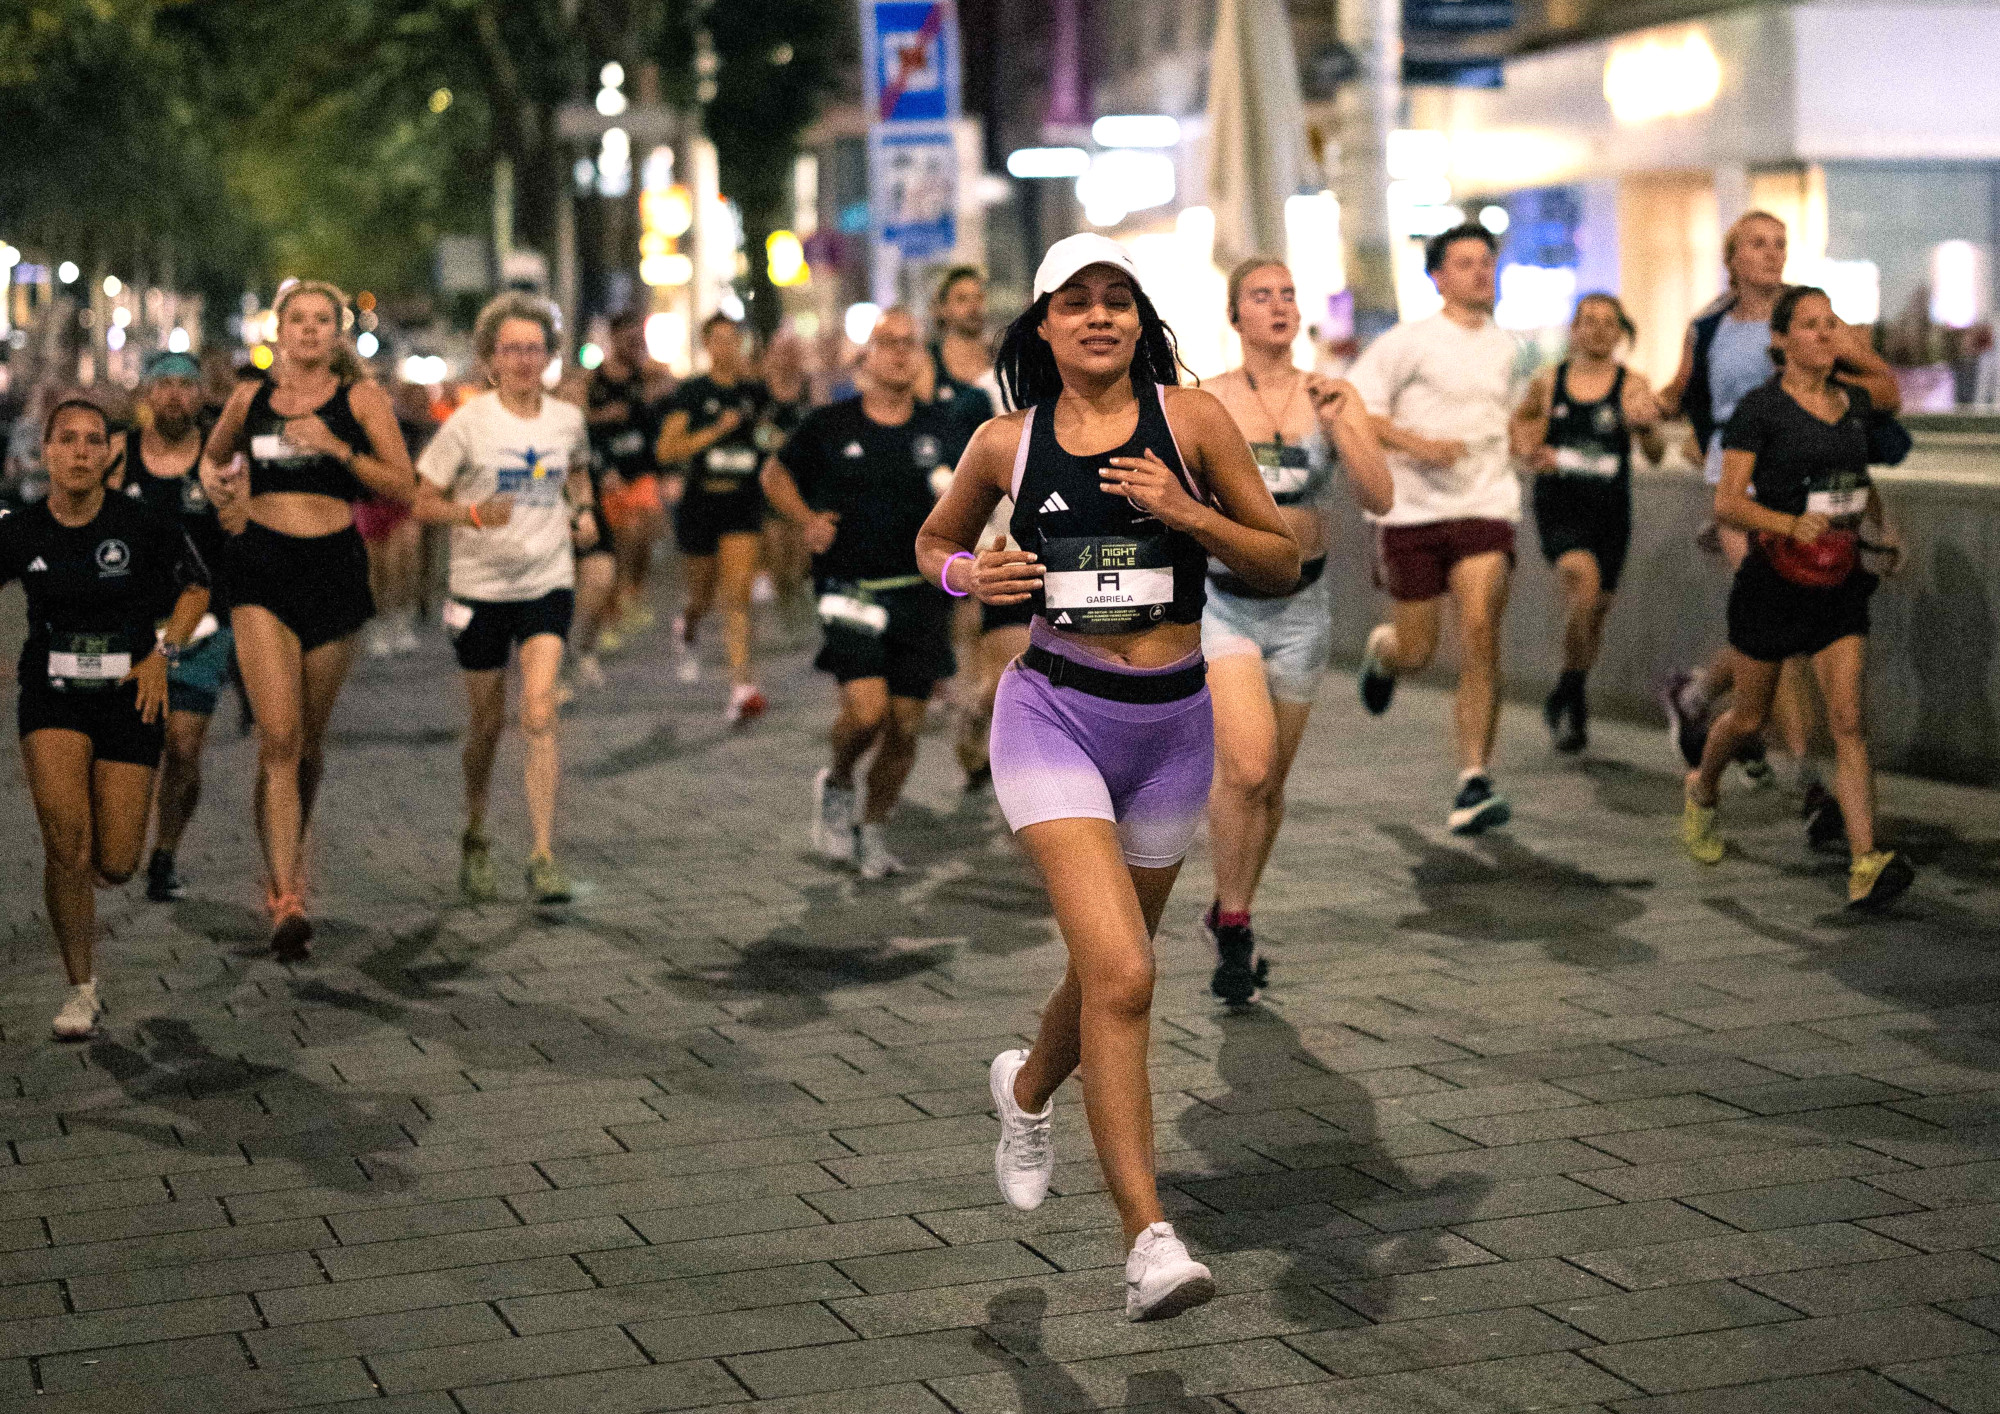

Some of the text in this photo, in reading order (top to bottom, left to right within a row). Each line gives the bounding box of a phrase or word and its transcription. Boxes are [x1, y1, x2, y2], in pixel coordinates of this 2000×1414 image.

[1102, 548, 1136, 556] NIGHT
[1102, 557, 1135, 566] MILE
[1097, 572, 1119, 591] A
[1086, 595, 1133, 603] GABRIELA
